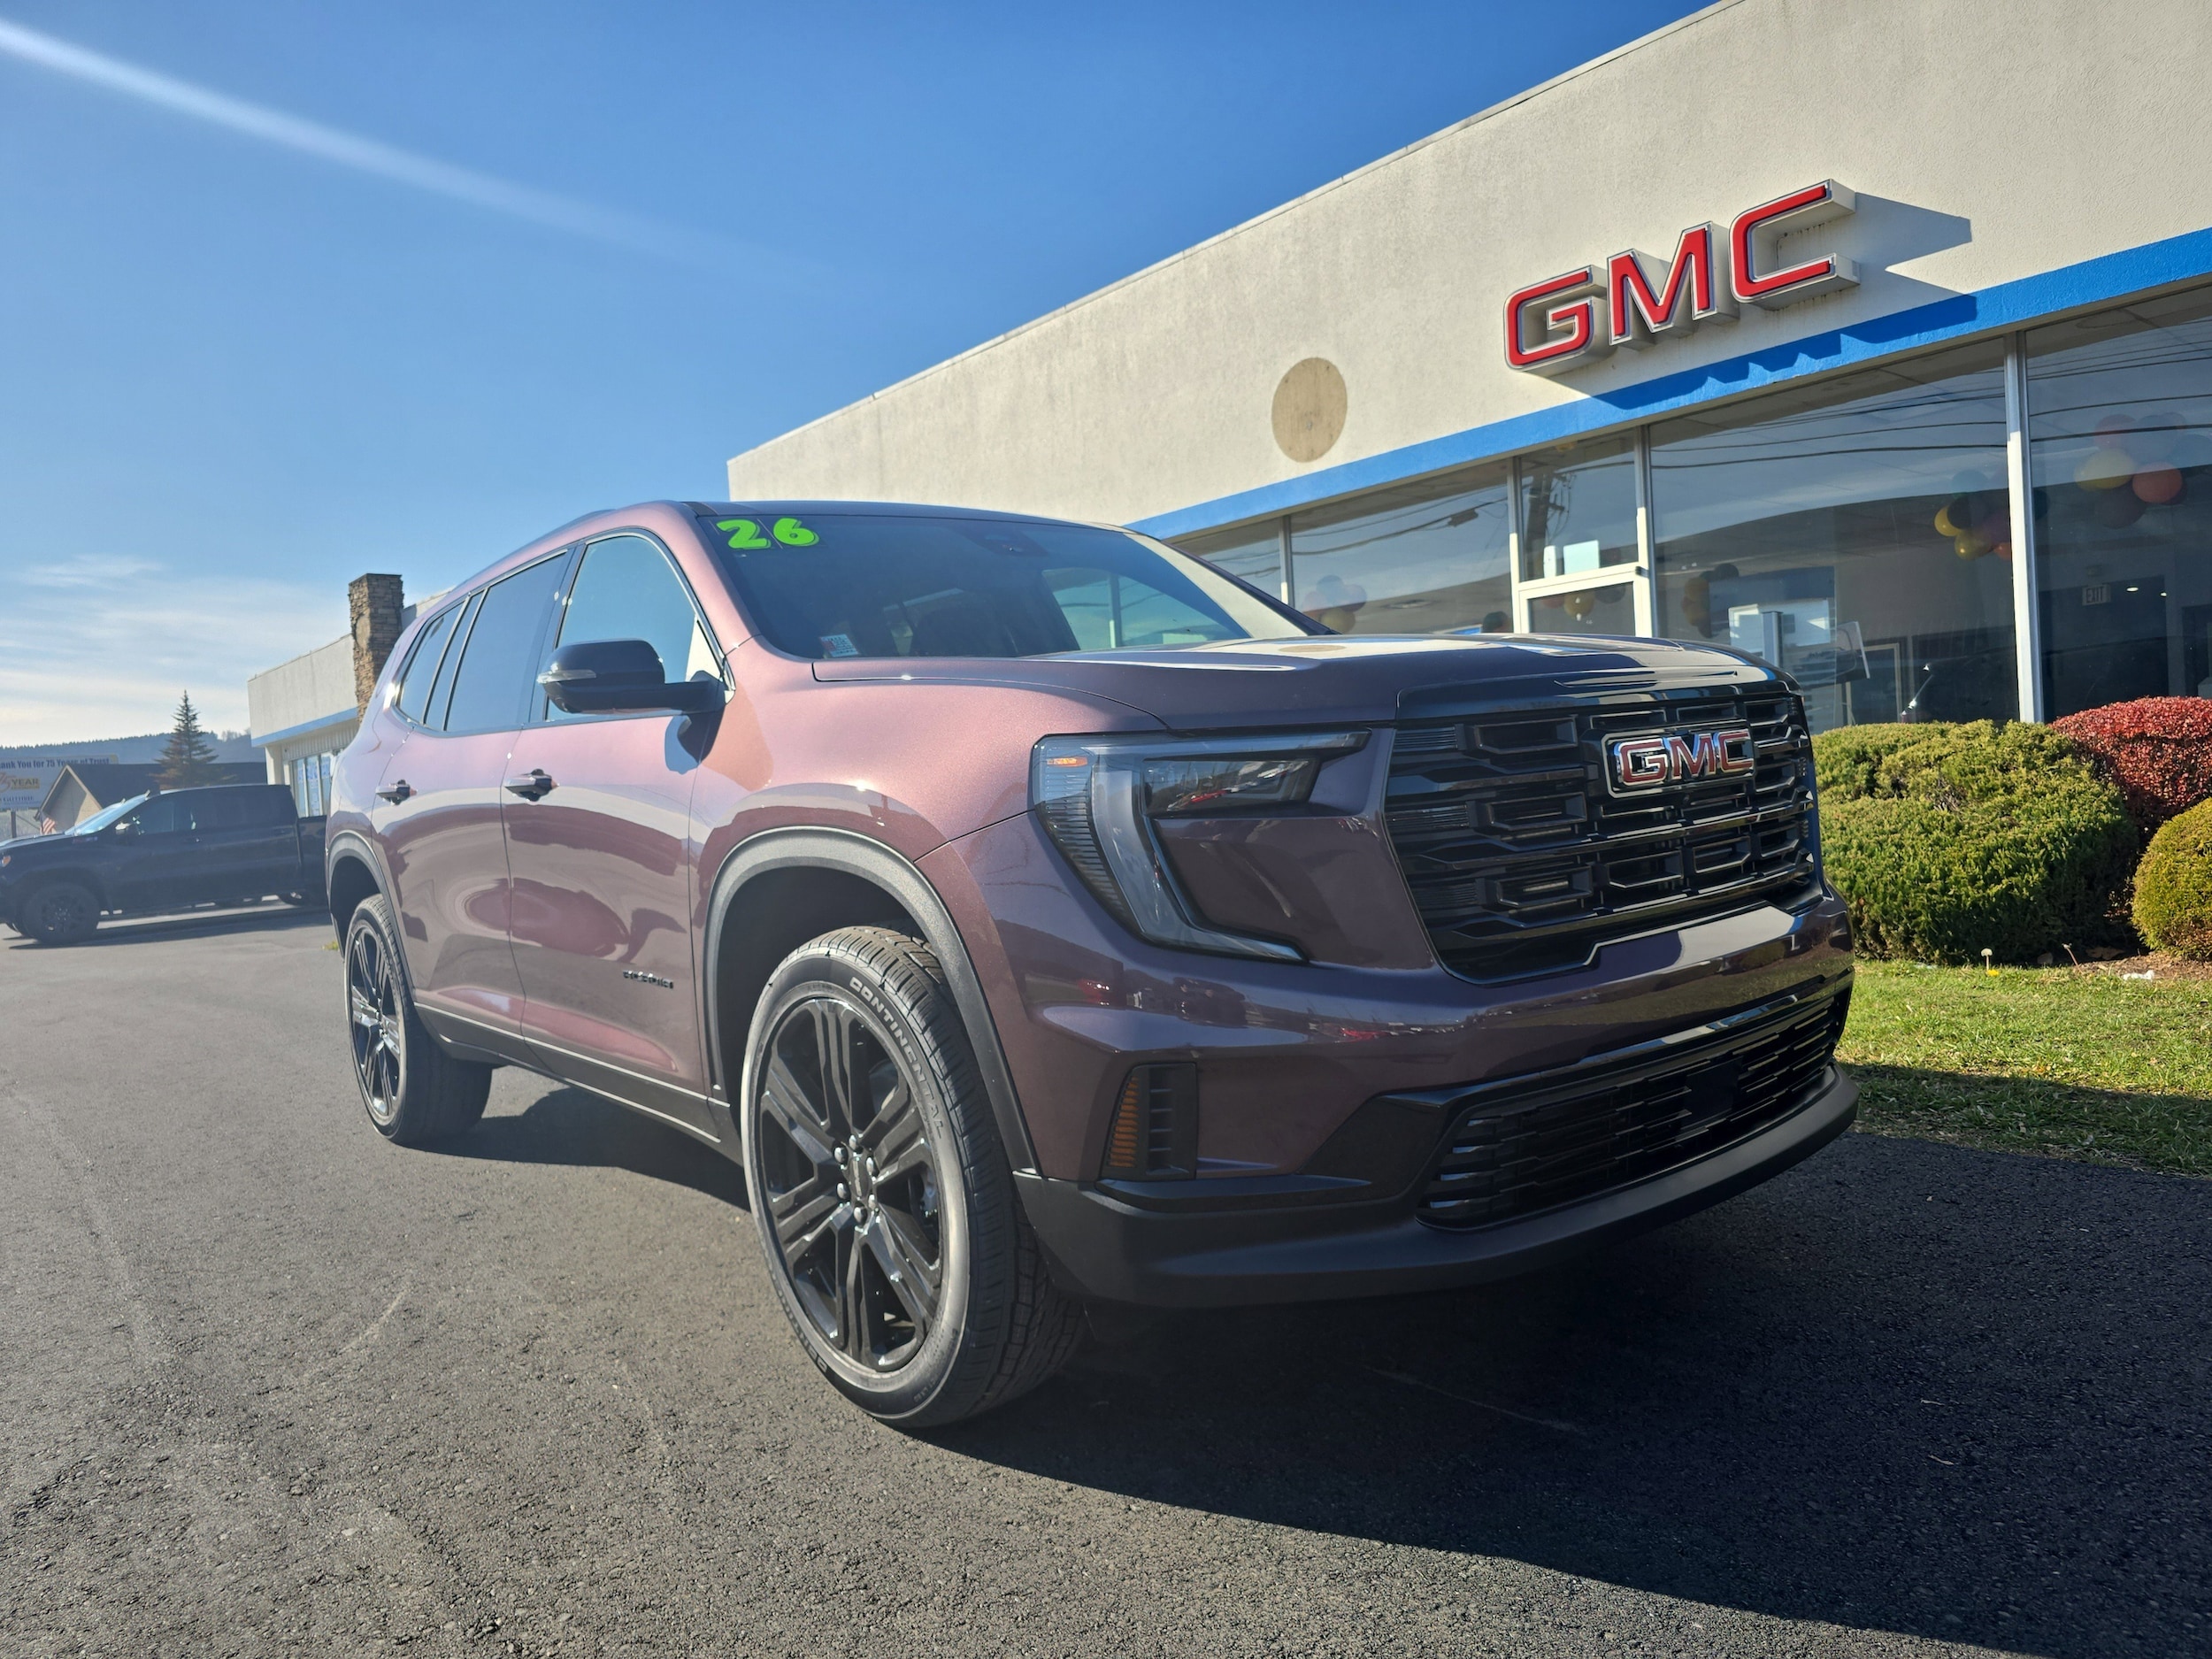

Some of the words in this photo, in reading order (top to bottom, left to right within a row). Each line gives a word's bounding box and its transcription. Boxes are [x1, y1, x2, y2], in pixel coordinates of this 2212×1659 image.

[1504, 179, 1847, 372] GMC
[716, 518, 820, 549] 26
[2086, 586, 2105, 603] EXIT
[0, 760, 16, 769] ank
[18, 760, 32, 769] You
[1615, 728, 1755, 787] GMC
[12, 778, 39, 787] YEAR
[849, 976, 946, 1140] CONTINENTAL
